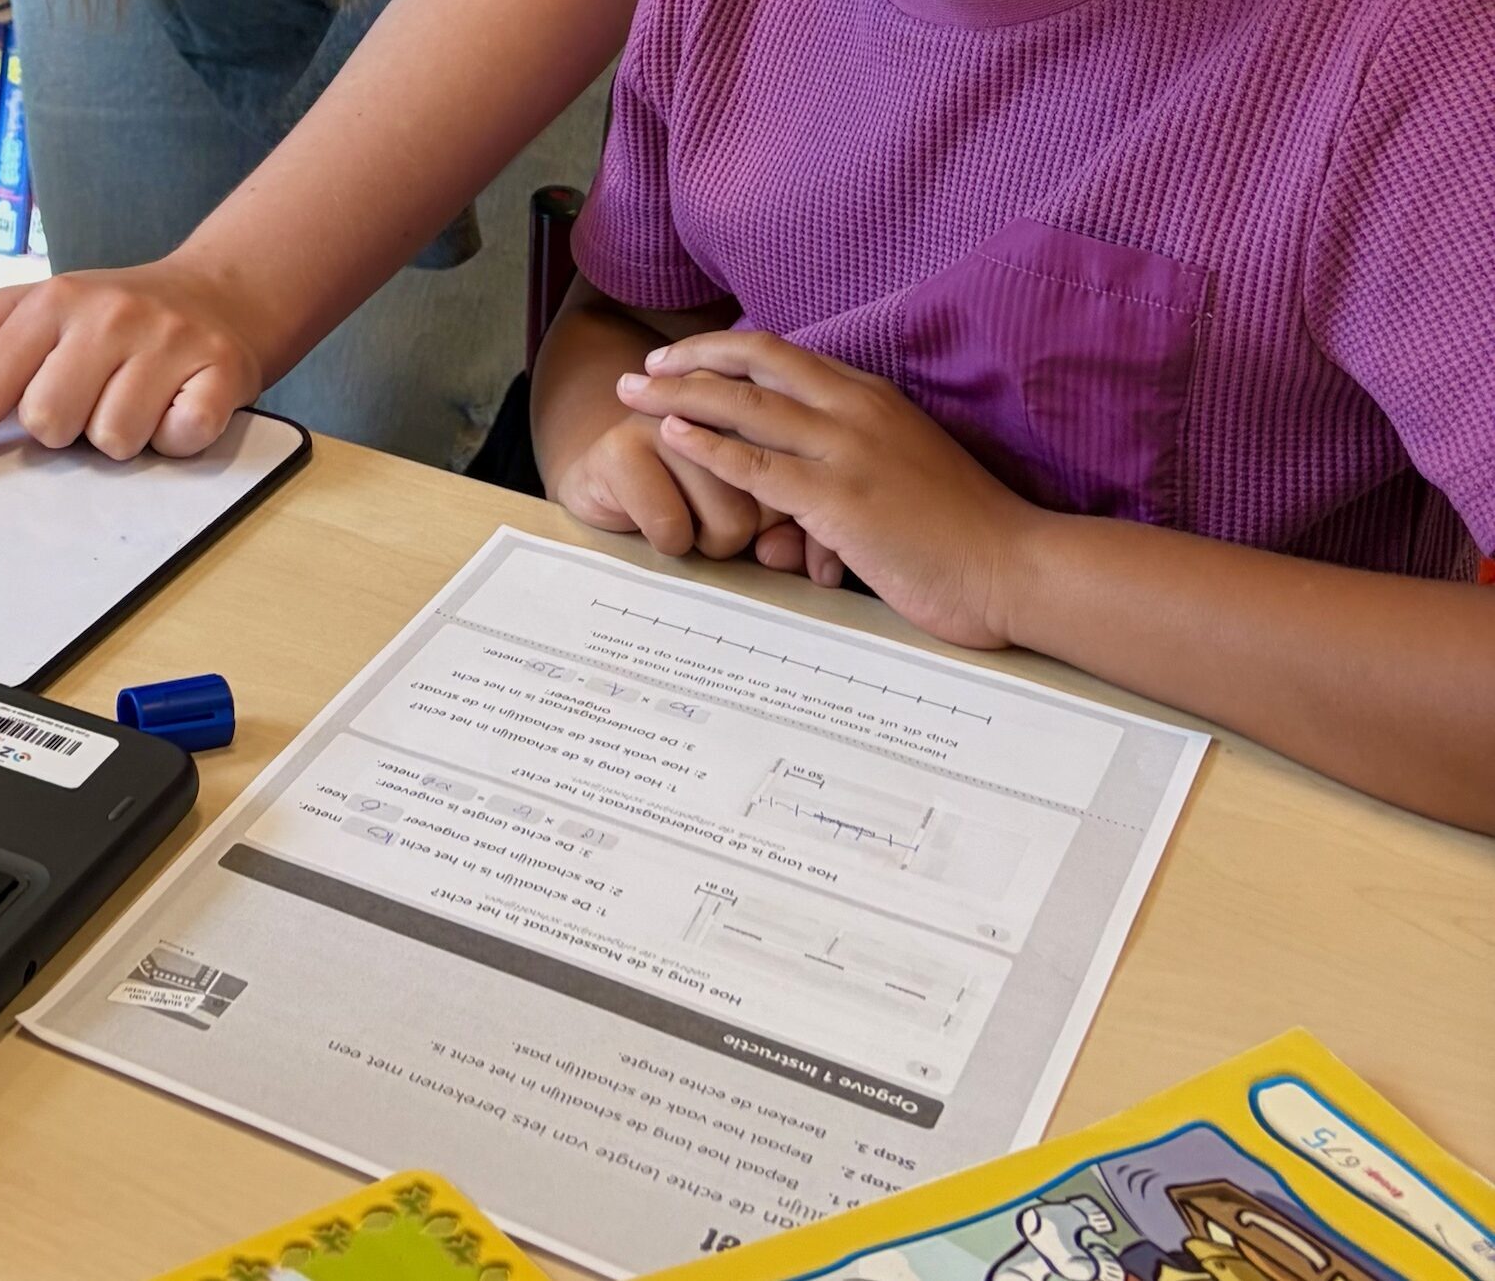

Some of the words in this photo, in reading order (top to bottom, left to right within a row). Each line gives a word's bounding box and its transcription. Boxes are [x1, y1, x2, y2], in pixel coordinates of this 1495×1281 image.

[590, 630, 634, 648] meten.
[483, 647, 524, 664] meter.
[584, 642, 629, 660] elkaar.
[636, 645, 651, 654] te
[653, 650, 672, 660] op
[632, 657, 671, 674] naast
[674, 656, 724, 675] straten
[451, 670, 481, 684] echt
[673, 669, 756, 699] schaallijnen
[726, 672, 745, 681] de
[747, 678, 771, 689] om
[410, 681, 460, 701] straat?
[483, 680, 506, 693] het
[508, 687, 522, 698] in
[774, 685, 798, 699] het
[461, 697, 480, 707] de
[524, 693, 536, 702] is
[544, 689, 611, 715] ongeveer:
[800, 693, 854, 714] gebruik
[409, 702, 447, 717] echt?
[482, 703, 496, 713] in
[759, 696, 827, 720] meerdere
[857, 711, 876, 721] en
[449, 713, 473, 727] het
[475, 721, 489, 732] in
[498, 707, 565, 734] schaallijn
[538, 697, 657, 740] Donderdagstraat
[830, 716, 871, 735] staan
[879, 718, 899, 729] uit
[567, 731, 586, 741] de
[902, 725, 923, 736] dit
[491, 726, 559, 754] schaallijn
[588, 737, 621, 752] past
[659, 735, 679, 747] De
[682, 742, 696, 752] 3:
[875, 731, 948, 760] Hieronder
[926, 733, 959, 749] Knip
[561, 750, 580, 761] de
[582, 757, 595, 767] is
[622, 747, 657, 764] vaak
[377, 760, 421, 780] meter.
[511, 767, 551, 784] echt?
[597, 760, 631, 779] lang
[660, 759, 690, 775] Hoe
[694, 770, 708, 780] 2:
[554, 781, 578, 795] het
[633, 774, 663, 789] Hoe
[666, 783, 677, 793] 1:
[316, 783, 348, 802] keer.
[375, 778, 445, 806] ongeveer:
[581, 789, 596, 801] in
[299, 801, 343, 823] meter.
[447, 802, 460, 813] is
[461, 807, 509, 830] lengte
[598, 795, 725, 845] Donderdagstraat
[403, 816, 470, 842] ongeveer
[511, 824, 552, 843] echte
[399, 838, 431, 854] echt
[473, 839, 508, 856] past
[554, 839, 575, 852] De
[578, 847, 593, 858] 3:
[727, 839, 748, 851] de
[751, 846, 764, 858] is
[434, 849, 459, 866] het
[462, 860, 477, 872] in
[509, 851, 582, 881] schaallijn
[767, 850, 803, 871] lang
[479, 866, 493, 877] is
[806, 865, 838, 883] Hoe
[495, 871, 569, 902] schaallijn
[584, 878, 606, 891] De
[609, 886, 624, 897] 2:
[430, 887, 473, 906] echt?
[571, 898, 592, 912] De
[475, 902, 502, 919] het
[504, 912, 520, 925] in
[596, 906, 607, 917] 1:
[522, 918, 623, 962] Mosselstraat
[626, 956, 647, 970] de
[651, 965, 664, 978] is
[667, 970, 705, 994] lang
[709, 987, 742, 1007] Hoe
[327, 1039, 362, 1059] een
[430, 1040, 446, 1056] is.
[511, 1041, 553, 1064] past.
[723, 1034, 819, 1078] Instructie
[366, 1054, 404, 1077] met
[449, 1048, 485, 1069] echt
[488, 1063, 517, 1083] het
[618, 1052, 675, 1083] lengte.
[520, 1076, 537, 1091] in
[555, 1058, 637, 1096] schaallijn
[823, 1070, 832, 1083] 1
[408, 1071, 507, 1121] berekenen
[678, 1076, 727, 1100] echte
[838, 1076, 919, 1114] Opgave
[540, 1084, 623, 1122] schaallijn
[639, 1092, 662, 1107] de
[730, 1096, 753, 1110] de
[666, 1101, 707, 1125] vaak
[511, 1113, 548, 1137] iets
[626, 1118, 649, 1133] de
[712, 1120, 746, 1140] hoe
[757, 1105, 827, 1140] Bereken
[552, 1129, 589, 1152] van
[652, 1126, 693, 1152] lang
[854, 1140, 869, 1155] 3.
[697, 1145, 731, 1166] hoe
[750, 1132, 814, 1165] Bepaal
[595, 1147, 661, 1182] lengte
[873, 1147, 917, 1171] Stap
[735, 1158, 800, 1191] Bepaal
[841, 1165, 856, 1180] 2.
[666, 1174, 723, 1203] echte
[728, 1198, 756, 1215] de
[828, 1192, 840, 1207] 1.
[776, 1196, 828, 1222] llijn
[762, 1210, 801, 1230] an
